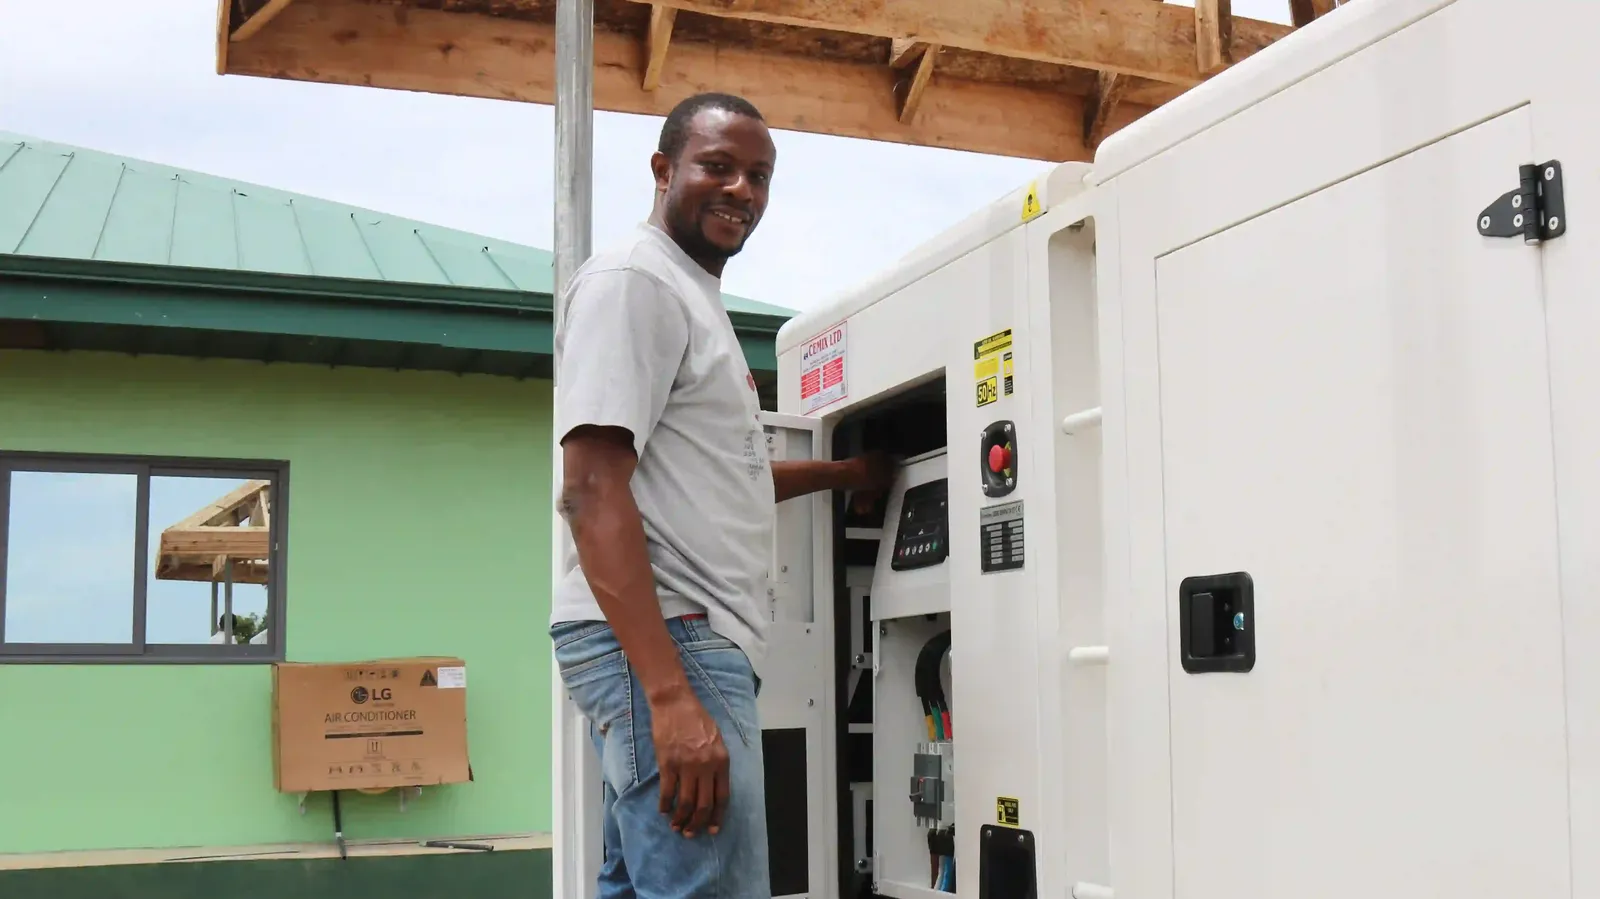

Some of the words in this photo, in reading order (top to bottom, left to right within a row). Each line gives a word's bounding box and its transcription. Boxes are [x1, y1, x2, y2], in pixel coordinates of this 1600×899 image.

[808, 337, 828, 356] CEMIX
[830, 329, 842, 346] LTD
[978, 384, 996, 402] 50Hz
[372, 688, 392, 700] LG
[325, 711, 341, 723] AIR
[344, 710, 416, 723] CONDITIONER
